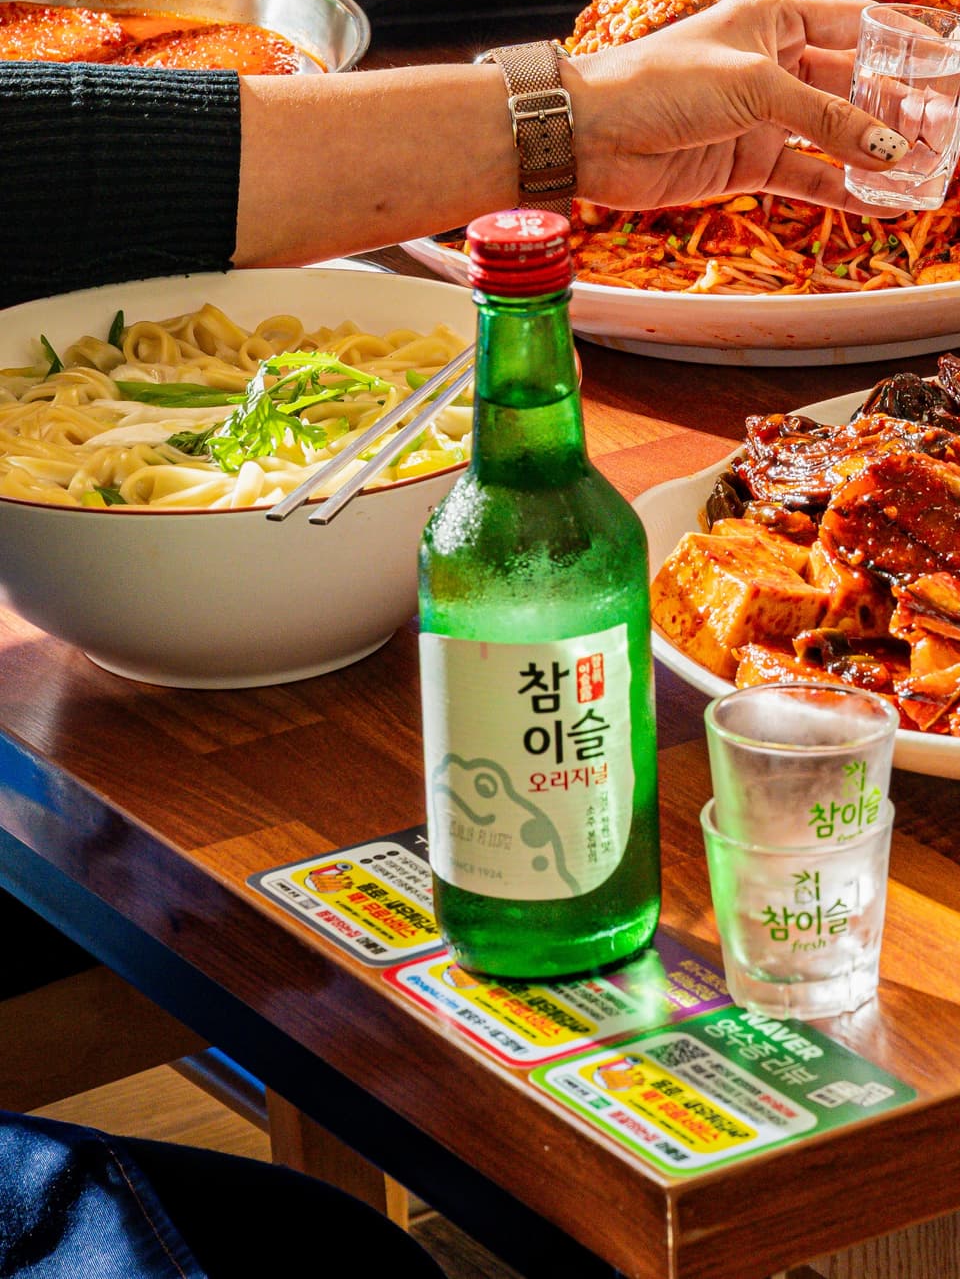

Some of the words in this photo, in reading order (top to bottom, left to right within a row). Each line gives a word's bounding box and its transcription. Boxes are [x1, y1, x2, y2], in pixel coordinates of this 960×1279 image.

[518, 661, 570, 714] 참
[523, 708, 611, 765] 이슬
[528, 762, 608, 792] 오리지널
[808, 786, 883, 840] 참이슬
[761, 898, 853, 942] 참이슬
[704, 1019, 779, 1061] 영수증
[760, 1054, 821, 1086] 리뷰
[740, 1008, 824, 1062] NAVER
